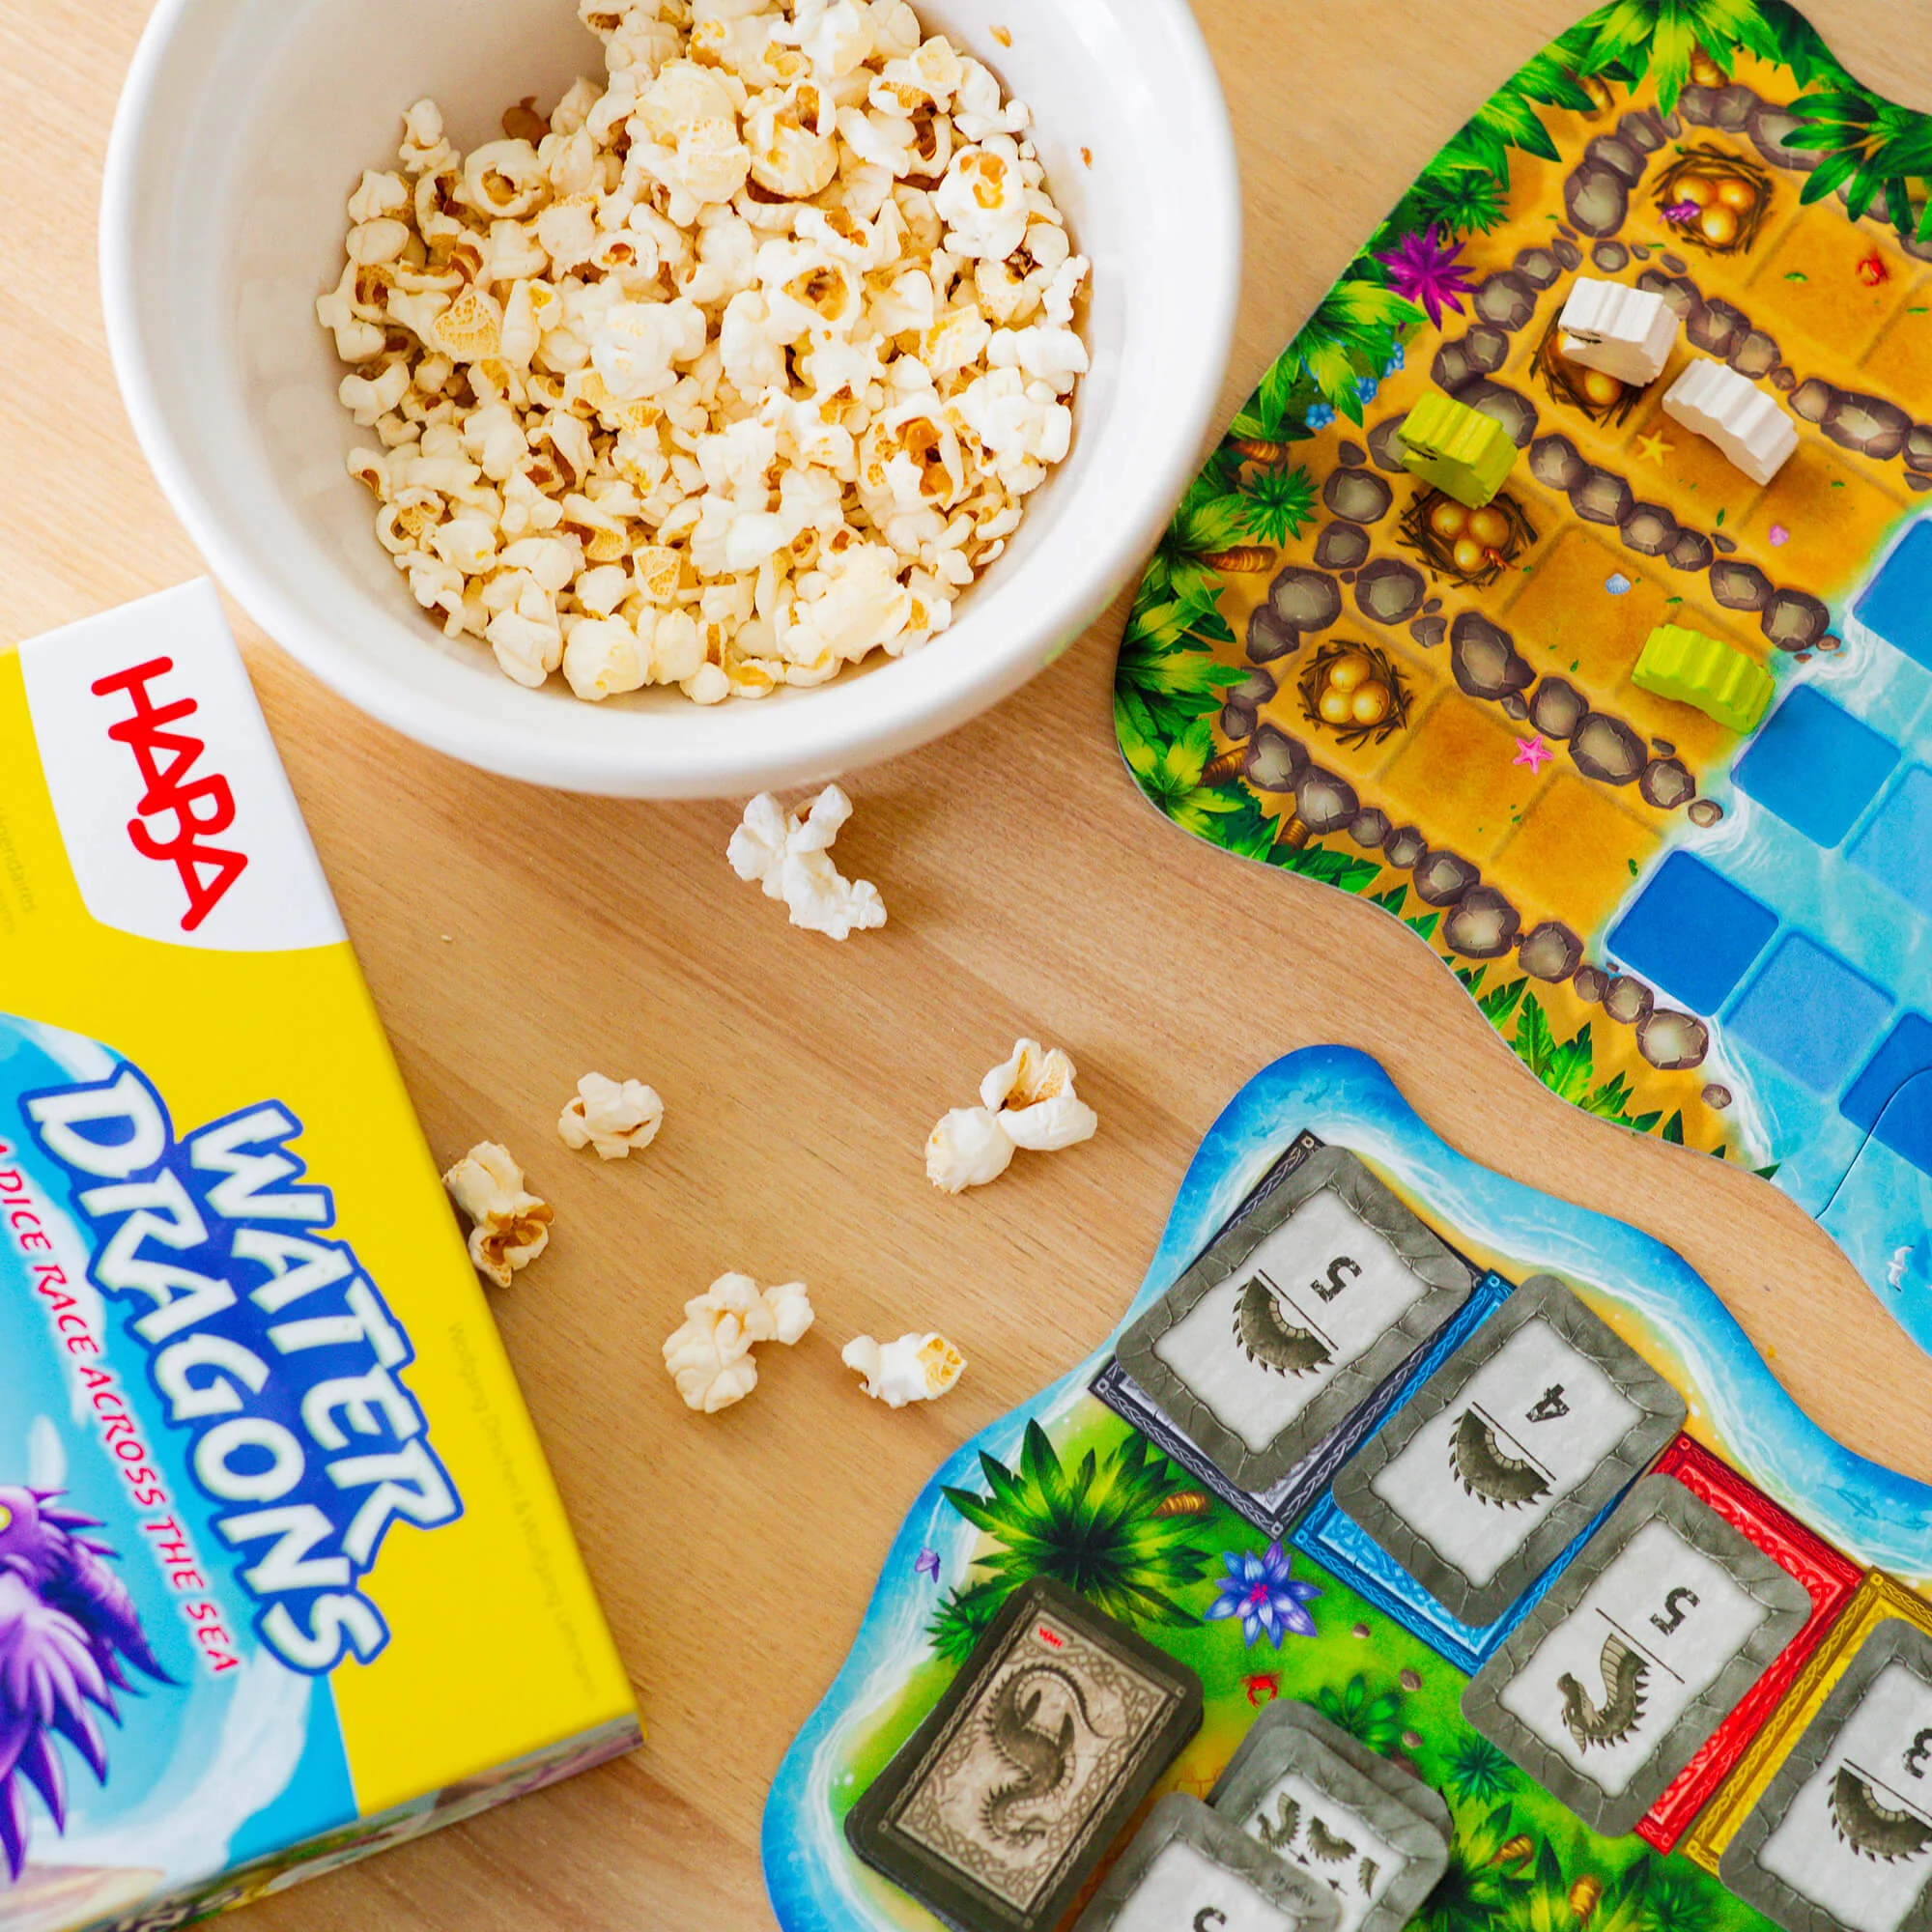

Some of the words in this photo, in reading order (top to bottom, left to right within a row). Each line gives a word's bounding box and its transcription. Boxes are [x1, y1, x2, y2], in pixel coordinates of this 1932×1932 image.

[91, 657, 247, 931] HABA
[21, 1064, 387, 1672] DRAGONS
[186, 1102, 461, 1570] WATER
[1309, 1256, 1362, 1303] 5
[1525, 1383, 1570, 1423] 4
[0, 1170, 51, 1250] DICE
[33, 1264, 100, 1353] RACE
[80, 1367, 166, 1506] ACROSS
[146, 1515, 204, 1592] THE
[186, 1603, 239, 1672] SEA
[1650, 1586, 1700, 1635] 5
